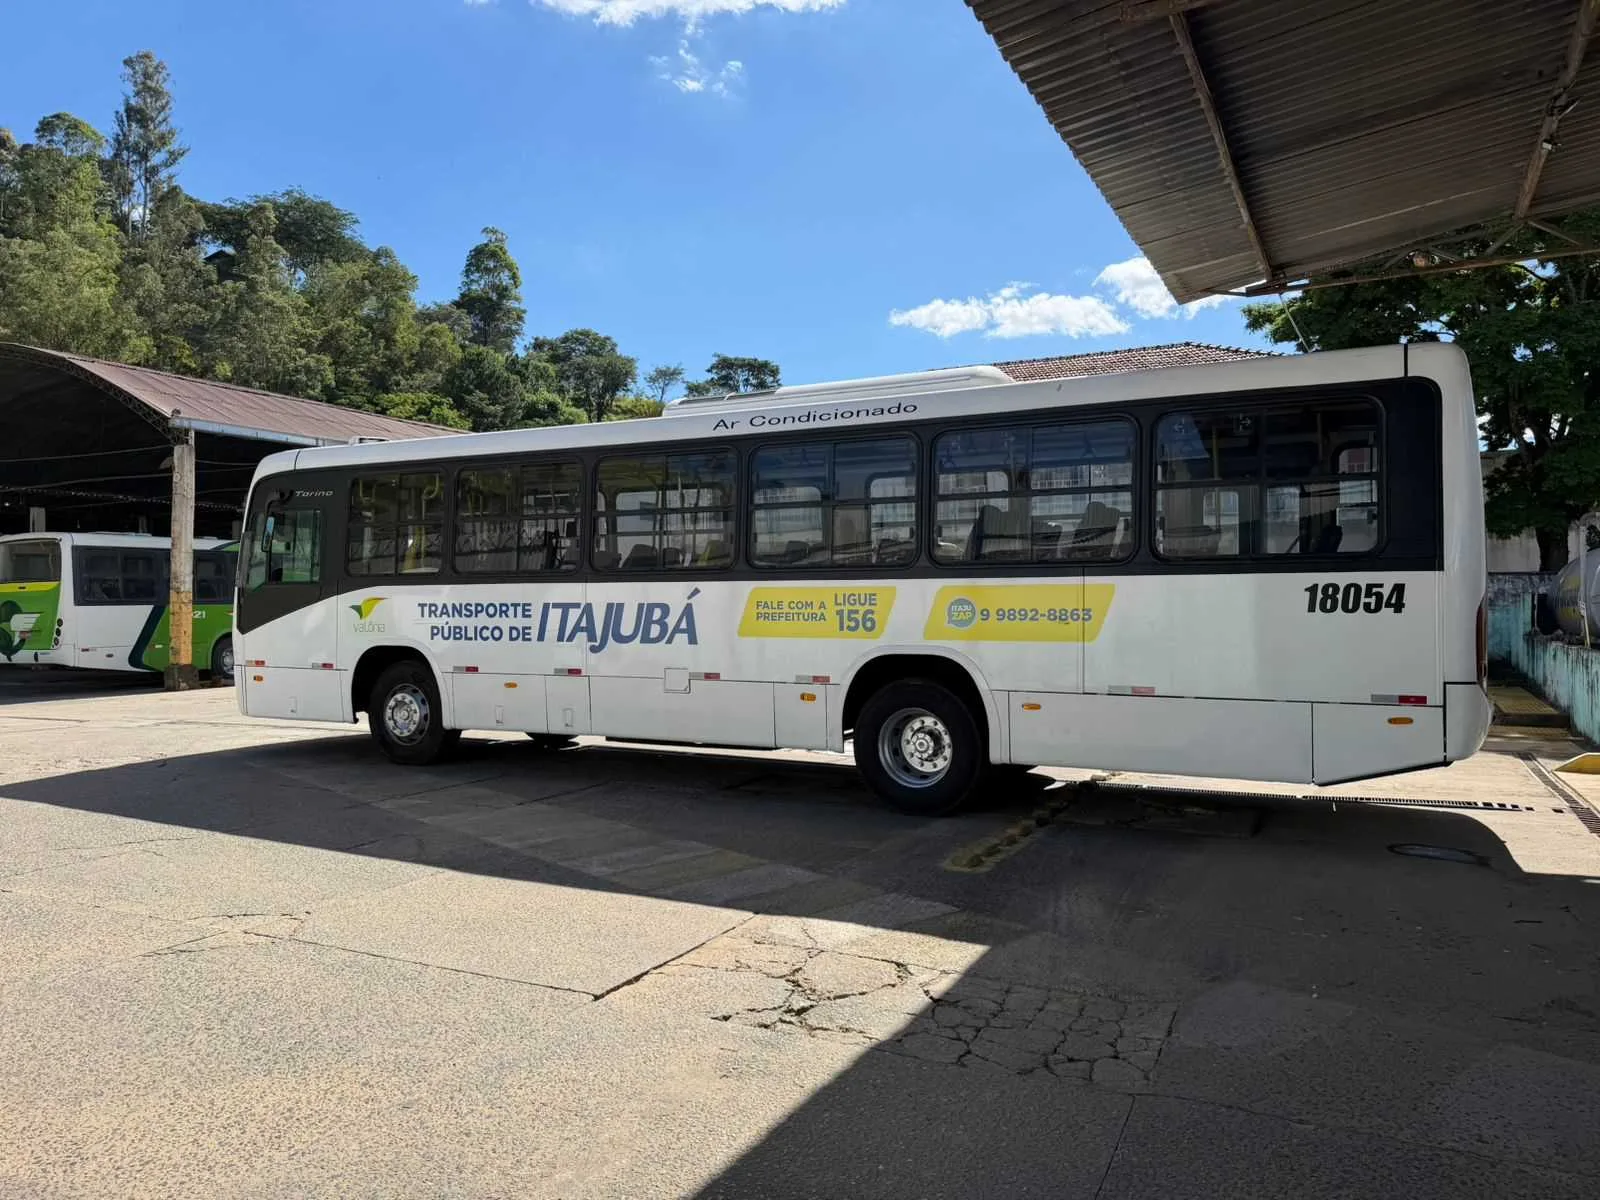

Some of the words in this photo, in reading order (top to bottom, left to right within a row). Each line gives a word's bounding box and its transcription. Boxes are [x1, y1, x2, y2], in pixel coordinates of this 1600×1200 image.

[712, 418, 740, 431] Ar
[749, 402, 918, 427] Condicionado
[295, 489, 334, 497] Torino
[755, 600, 784, 611] FALE
[787, 600, 814, 610] COM
[818, 600, 827, 610] A
[834, 592, 877, 607] LIGUE
[1304, 582, 1406, 614] 18054
[417, 602, 532, 619] TRANSPORTE
[755, 611, 827, 622] PREFEITURA
[980, 607, 991, 621] 9
[995, 607, 1093, 622] 9892-8863
[536, 586, 701, 654] ITAJUBÁ
[835, 608, 877, 632] 156
[429, 621, 504, 642] PÚBLICO
[508, 625, 532, 642] DE
